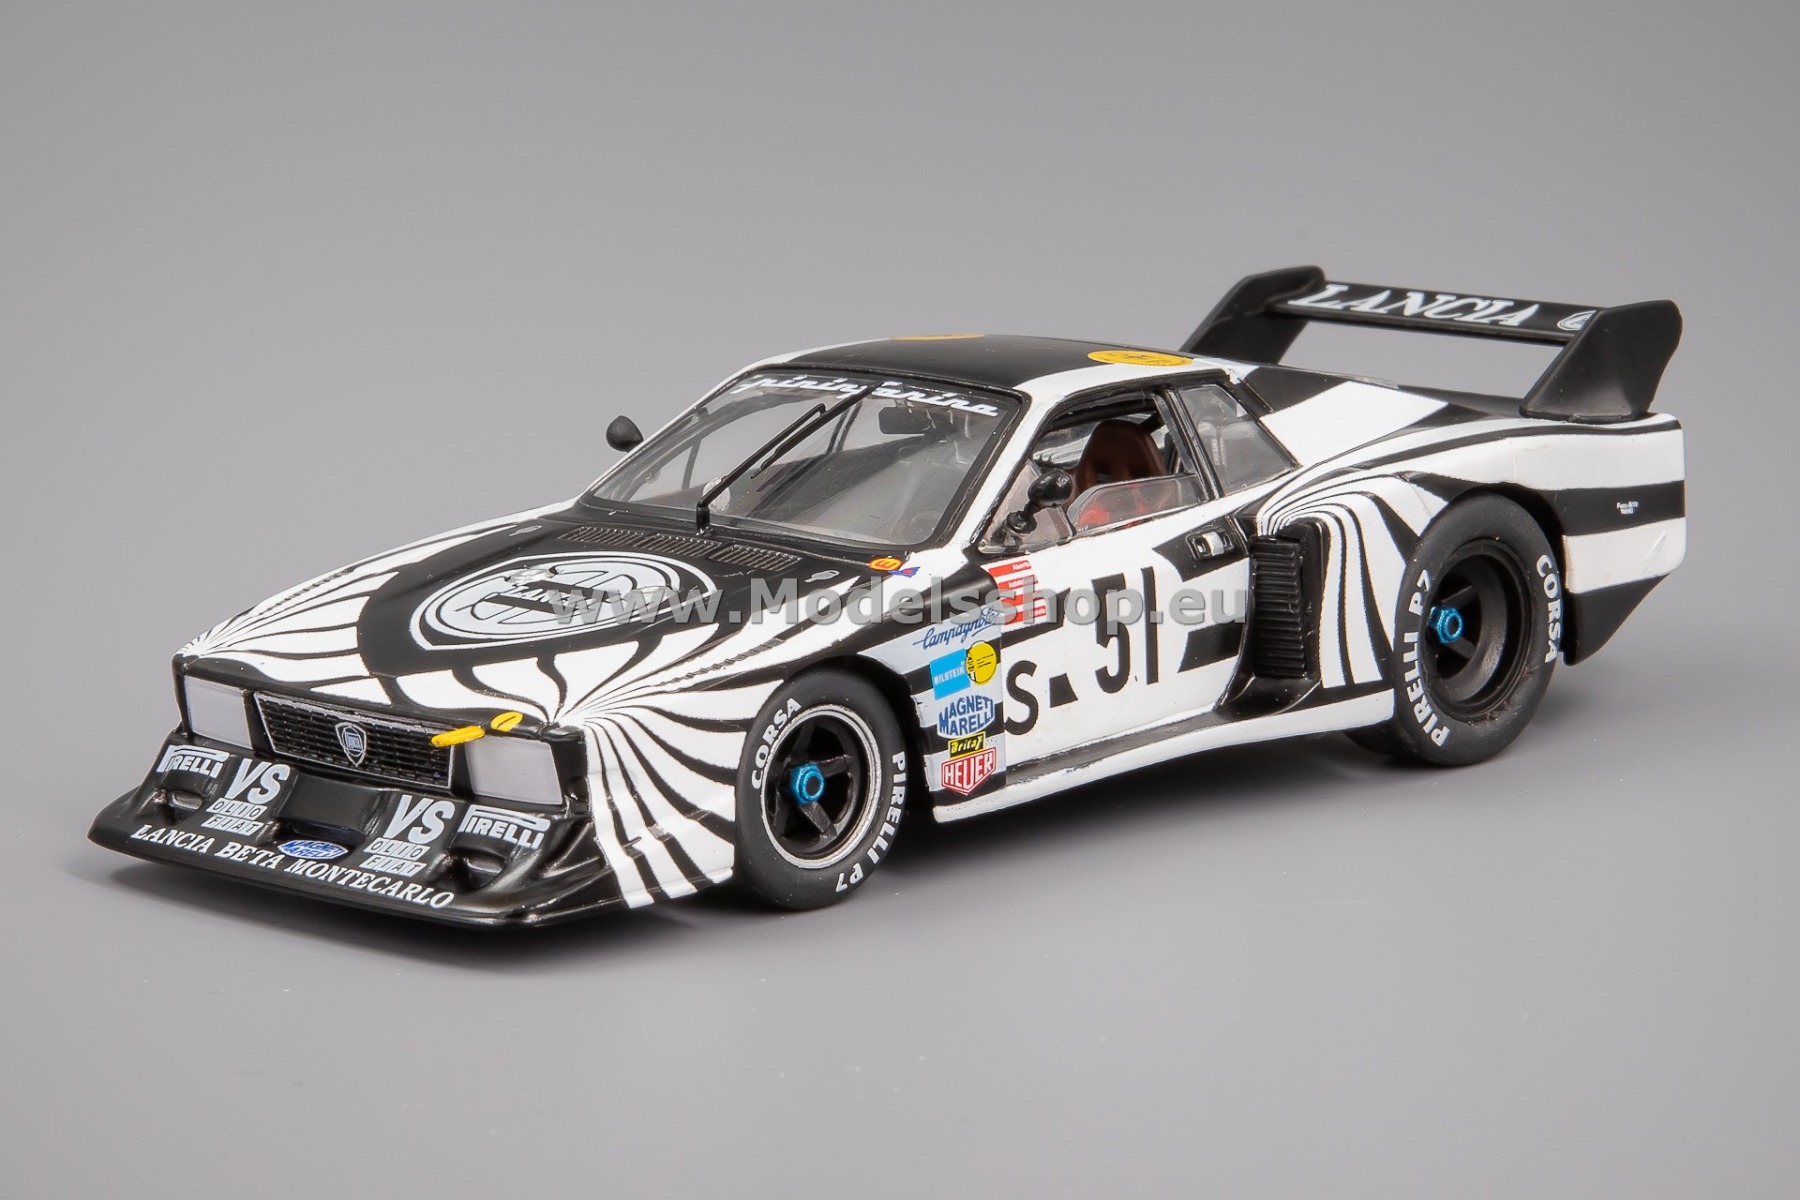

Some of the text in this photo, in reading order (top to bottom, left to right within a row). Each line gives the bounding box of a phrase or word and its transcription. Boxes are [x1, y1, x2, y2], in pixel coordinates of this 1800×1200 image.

[1288, 284, 1540, 327] LANCIA
[1091, 566, 1159, 694] 51
[1536, 554, 1562, 664] CORSA
[1403, 569, 1450, 747] PIRELLI P7
[939, 694, 994, 721] MAGNETI
[1004, 660, 1039, 735] S
[752, 697, 802, 789] CORSA
[939, 711, 994, 736] MARELLI
[156, 745, 230, 779] PIRELLI
[224, 758, 291, 805] VS
[944, 752, 993, 790] HEUER
[201, 814, 265, 836] FIAT
[206, 798, 267, 820] OLIO
[383, 794, 456, 845] VS
[457, 804, 551, 850] PIRELLI
[835, 751, 907, 892] PIRELLI P7
[131, 824, 455, 910] LANCIA BETA MONTECARLO
[359, 854, 427, 877] FIAT
[363, 837, 430, 860] OLIO
